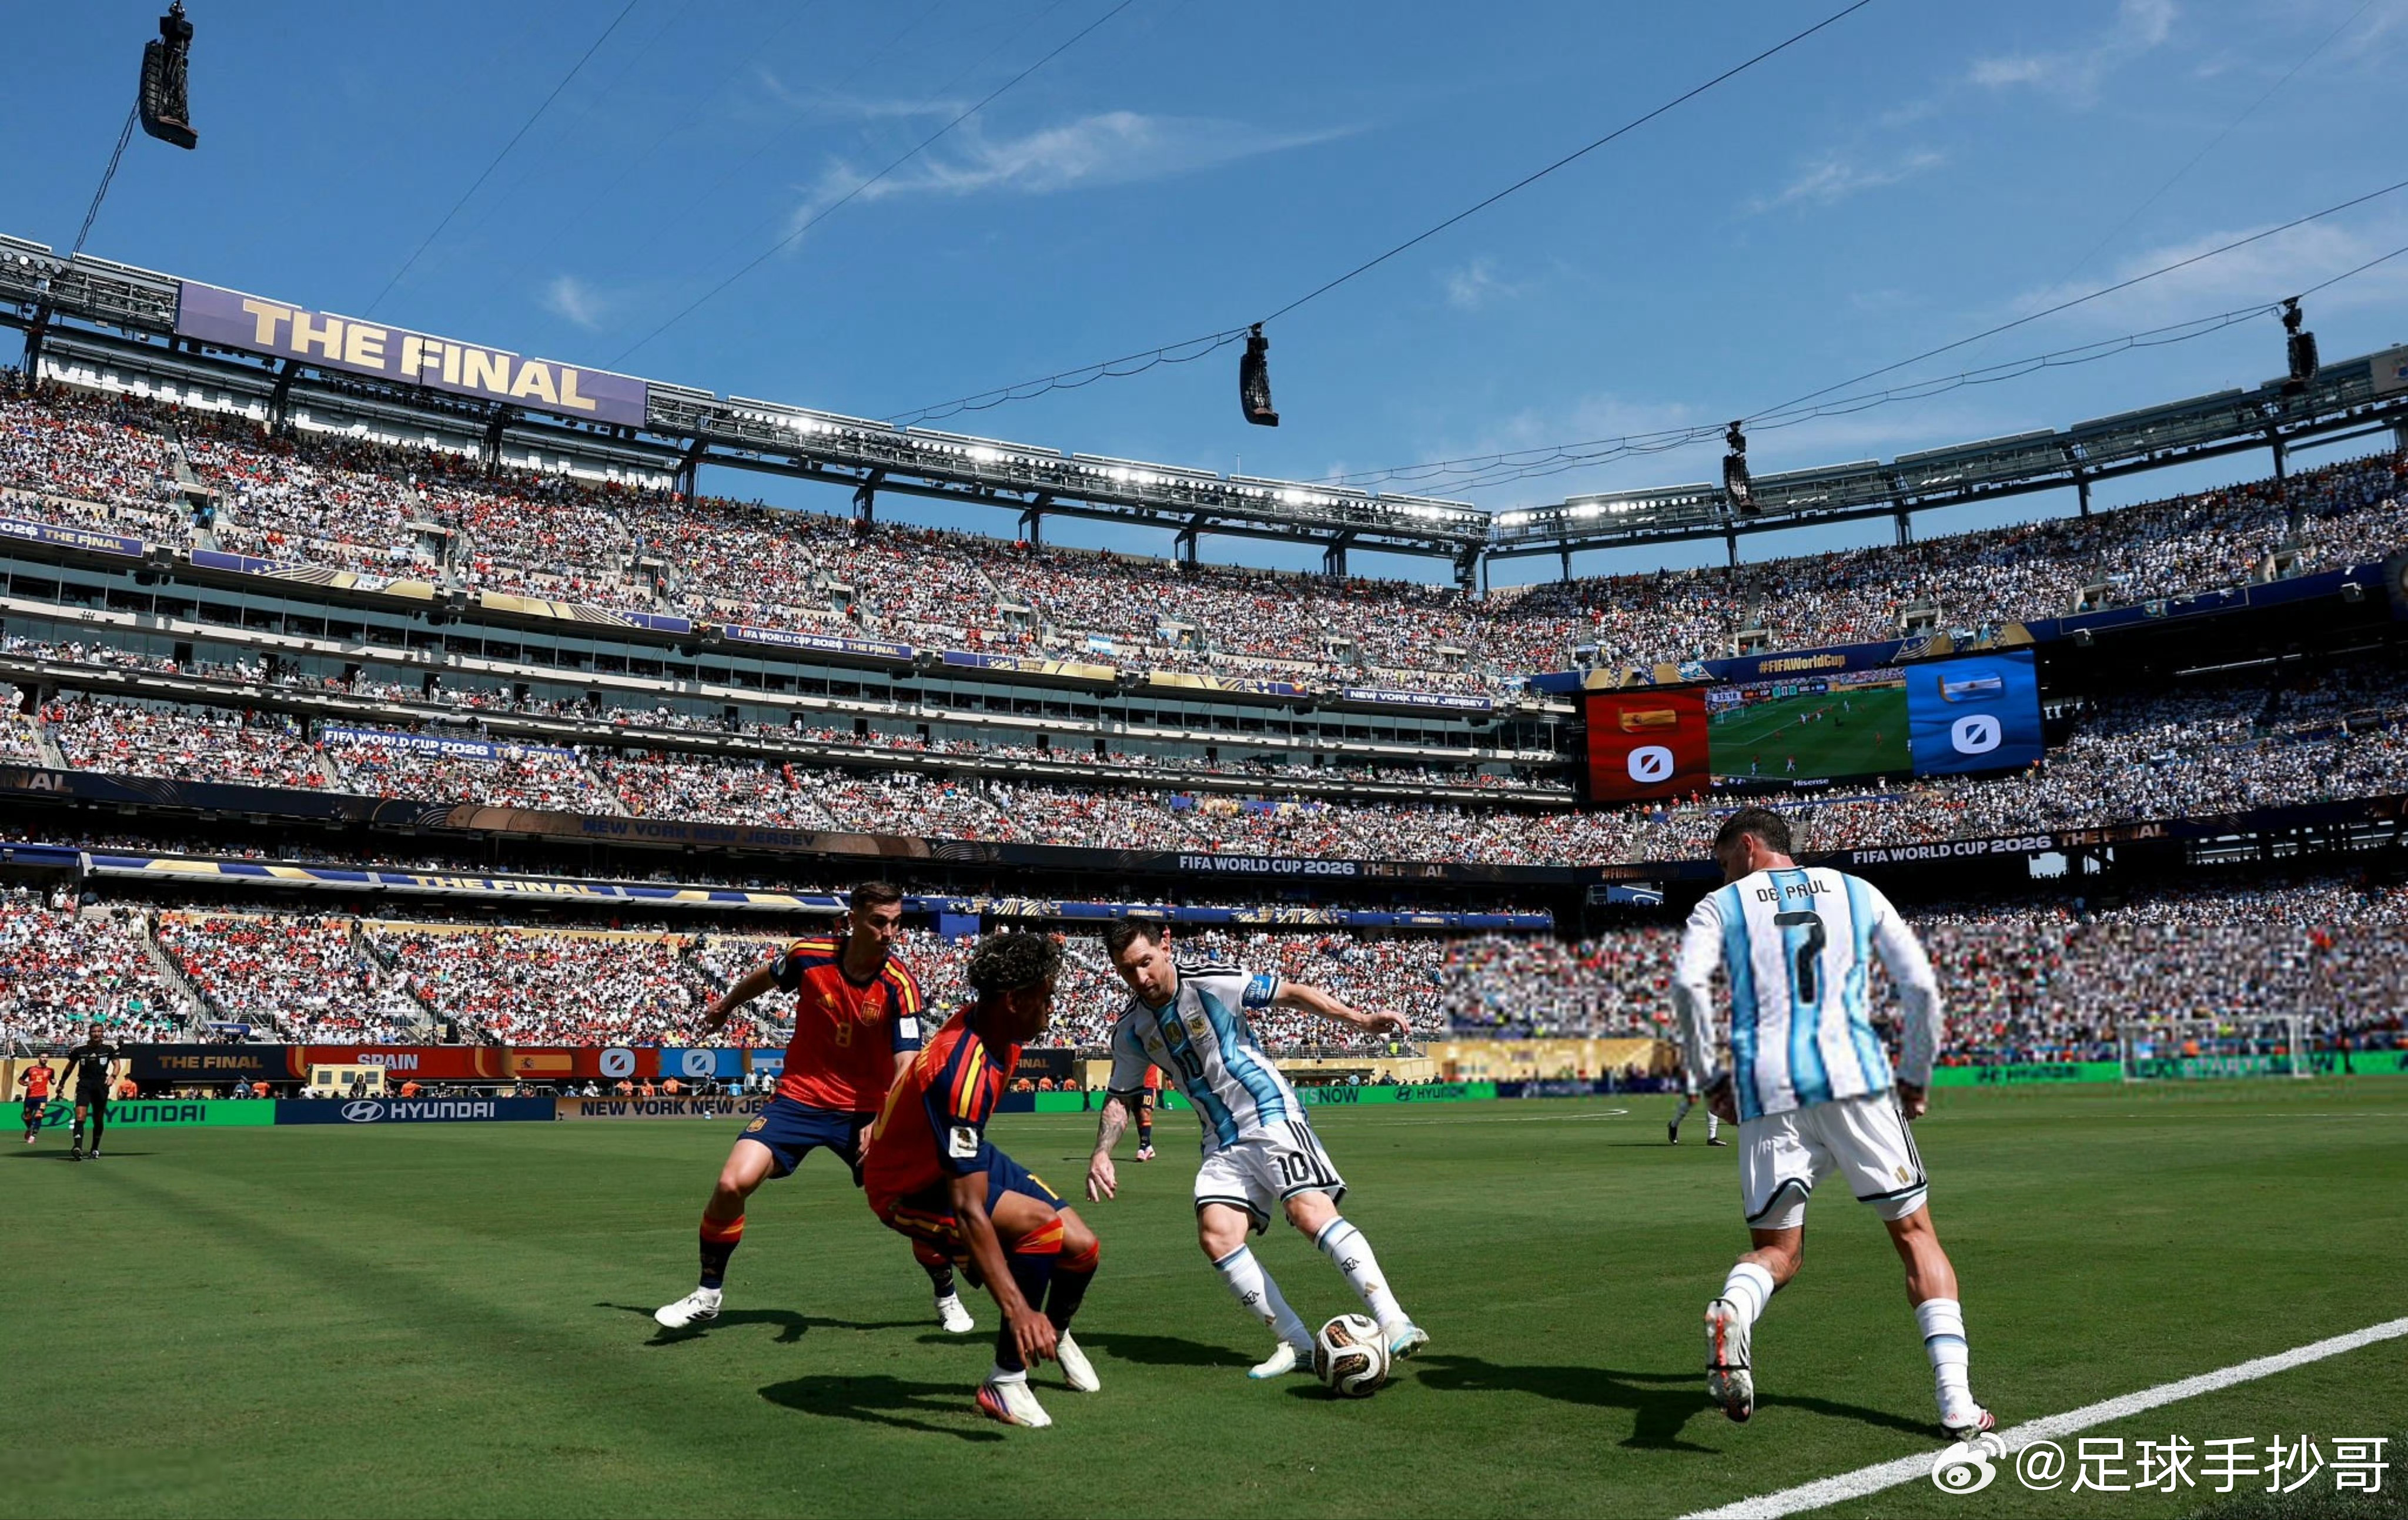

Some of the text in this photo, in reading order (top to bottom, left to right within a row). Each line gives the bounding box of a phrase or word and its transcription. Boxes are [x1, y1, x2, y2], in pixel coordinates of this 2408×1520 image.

[243, 300, 596, 410] THE FINAL
[0, 522, 125, 550] 026 THE FINAL
[758, 631, 791, 643] WORLD
[793, 636, 811, 645] CUP
[812, 638, 843, 648] 2026
[847, 642, 867, 651] THE
[868, 644, 899, 655] FINAL
[1759, 654, 1845, 674] #FIFAWorldCup
[1350, 691, 1484, 707] NEW YORK NEW JERSEY
[1951, 714, 2001, 754] 0
[412, 738, 440, 749] CUP
[442, 742, 489, 756] 2026
[1627, 745, 1674, 782] 0
[0, 770, 73, 793] NAL
[1794, 778, 1829, 787] Hisense
[583, 819, 815, 846] NEW YORK NEW JERSEY
[1853, 851, 1889, 865] FIFA
[1891, 844, 1952, 862] WORLD
[1954, 841, 1988, 857] CUP
[1991, 835, 2052, 853] 2026
[2060, 832, 2100, 847] THE
[1179, 855, 1212, 870] FIFA
[1214, 857, 1269, 873] WORLD
[1272, 859, 1302, 874] CUP
[1304, 861, 1355, 875] 2026
[1362, 863, 1394, 876] THE
[408, 875, 601, 896] THE FINAL
[1756, 880, 1831, 902] DE PAUL
[835, 1022, 852, 1047] 8
[158, 1056, 262, 1069] THE FINAL
[357, 1054, 418, 1070] SPAIN
[599, 1049, 716, 1077] 0 0
[1016, 1059, 1050, 1069] INAL
[392, 1102, 494, 1119] HYUNDAI
[581, 1101, 627, 1116] NEW
[633, 1100, 687, 1116] YORK
[691, 1100, 734, 1114] NEW
[1277, 1151, 1309, 1186] 10
